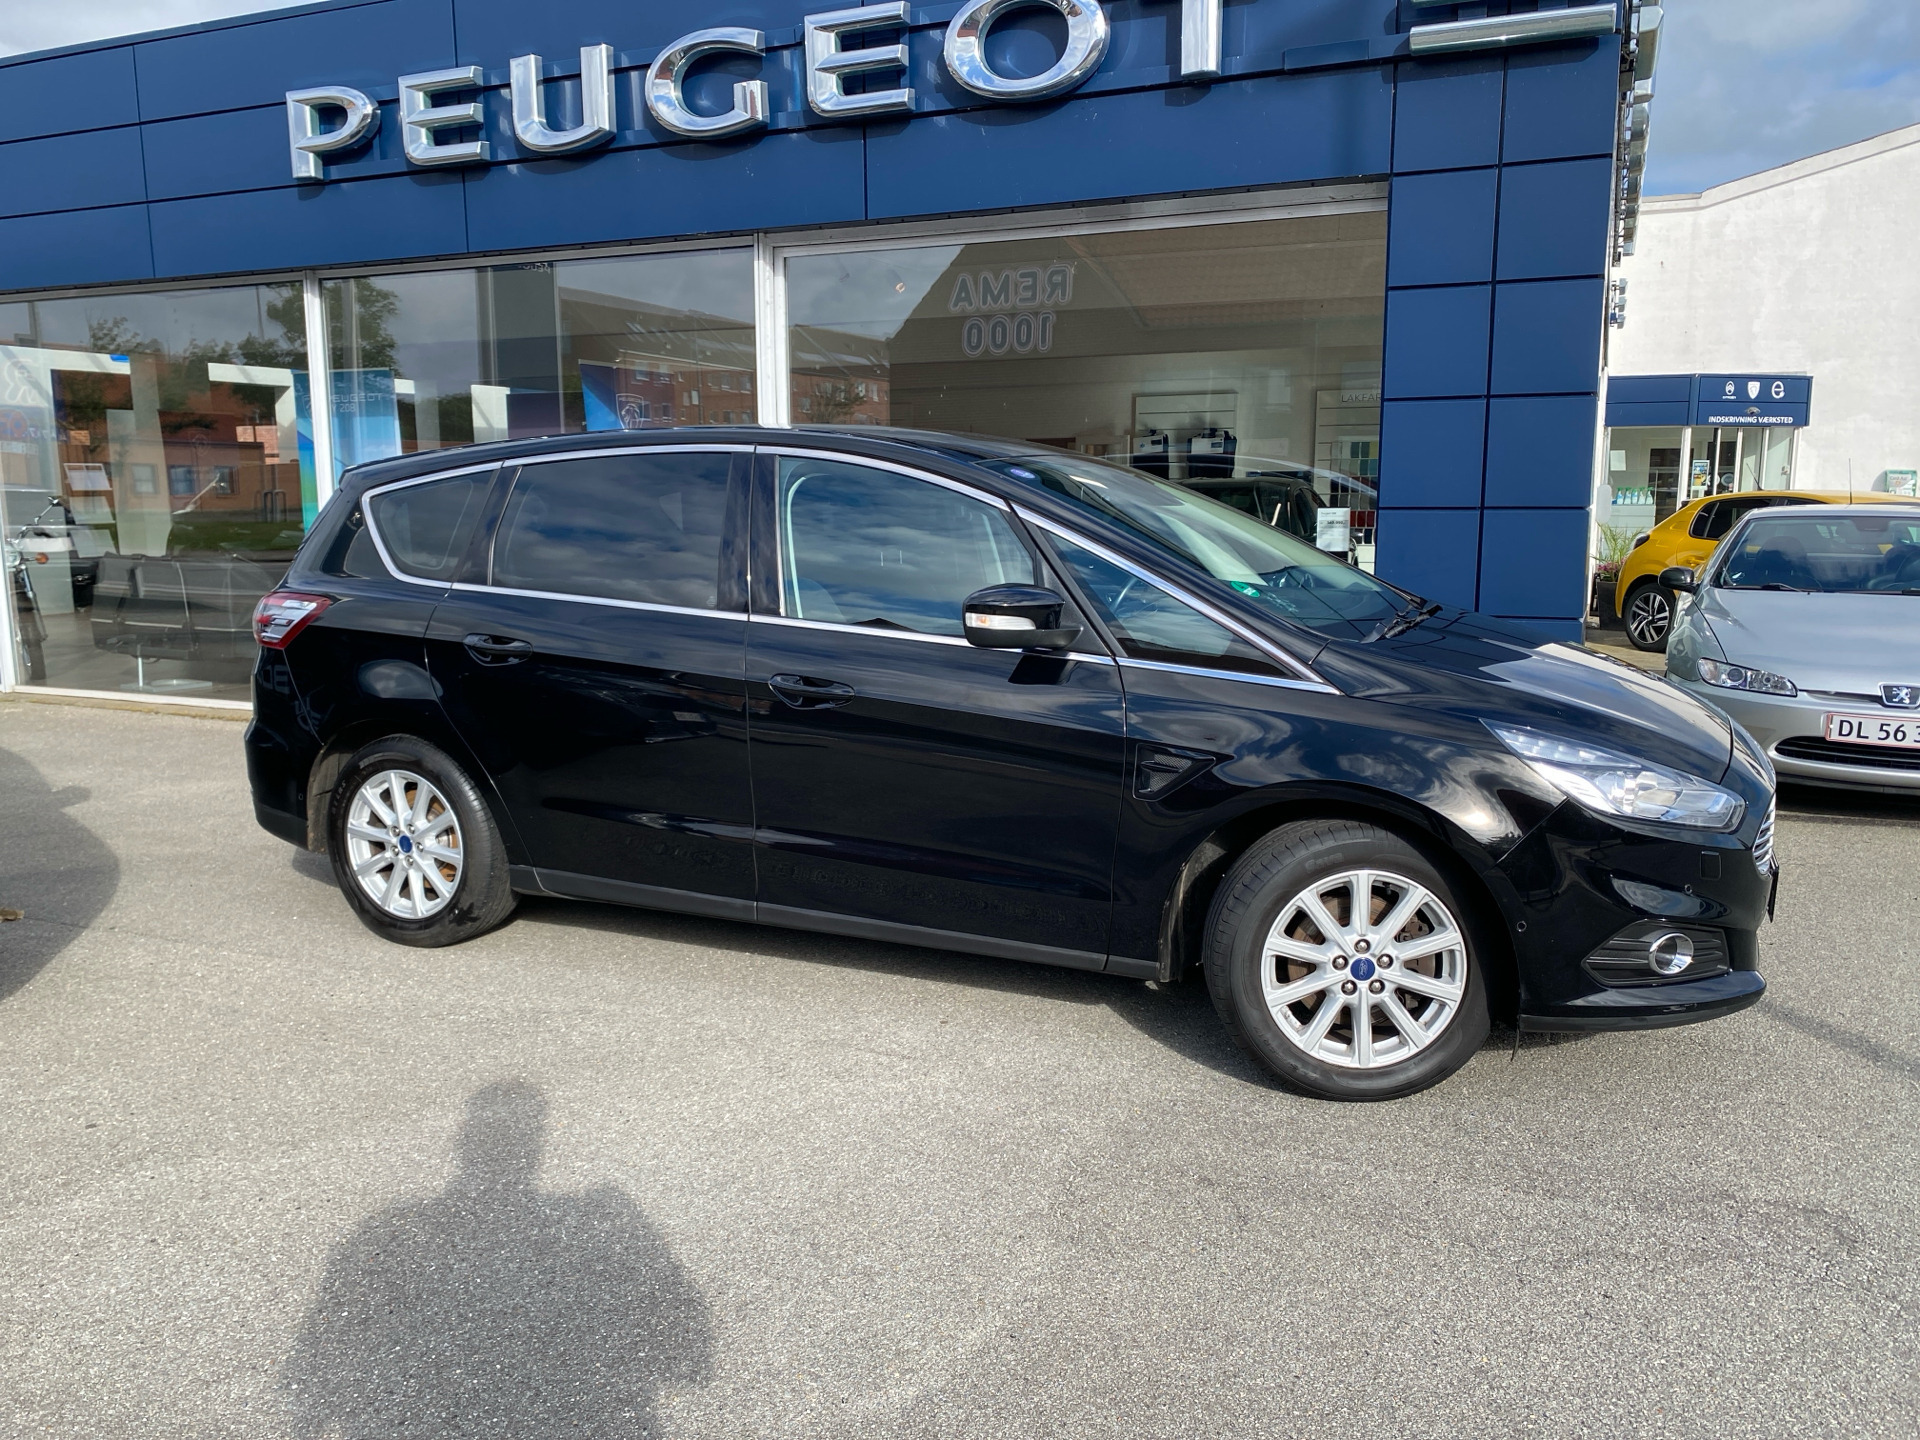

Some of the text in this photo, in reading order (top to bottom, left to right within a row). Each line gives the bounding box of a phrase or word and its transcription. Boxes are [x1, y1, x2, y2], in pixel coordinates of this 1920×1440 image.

[330, 392, 383, 403] EUGEOT
[1708, 416, 1757, 424] INDSKRIVNING
[1838, 720, 1869, 739] DL
[1878, 723, 1907, 742] 56
